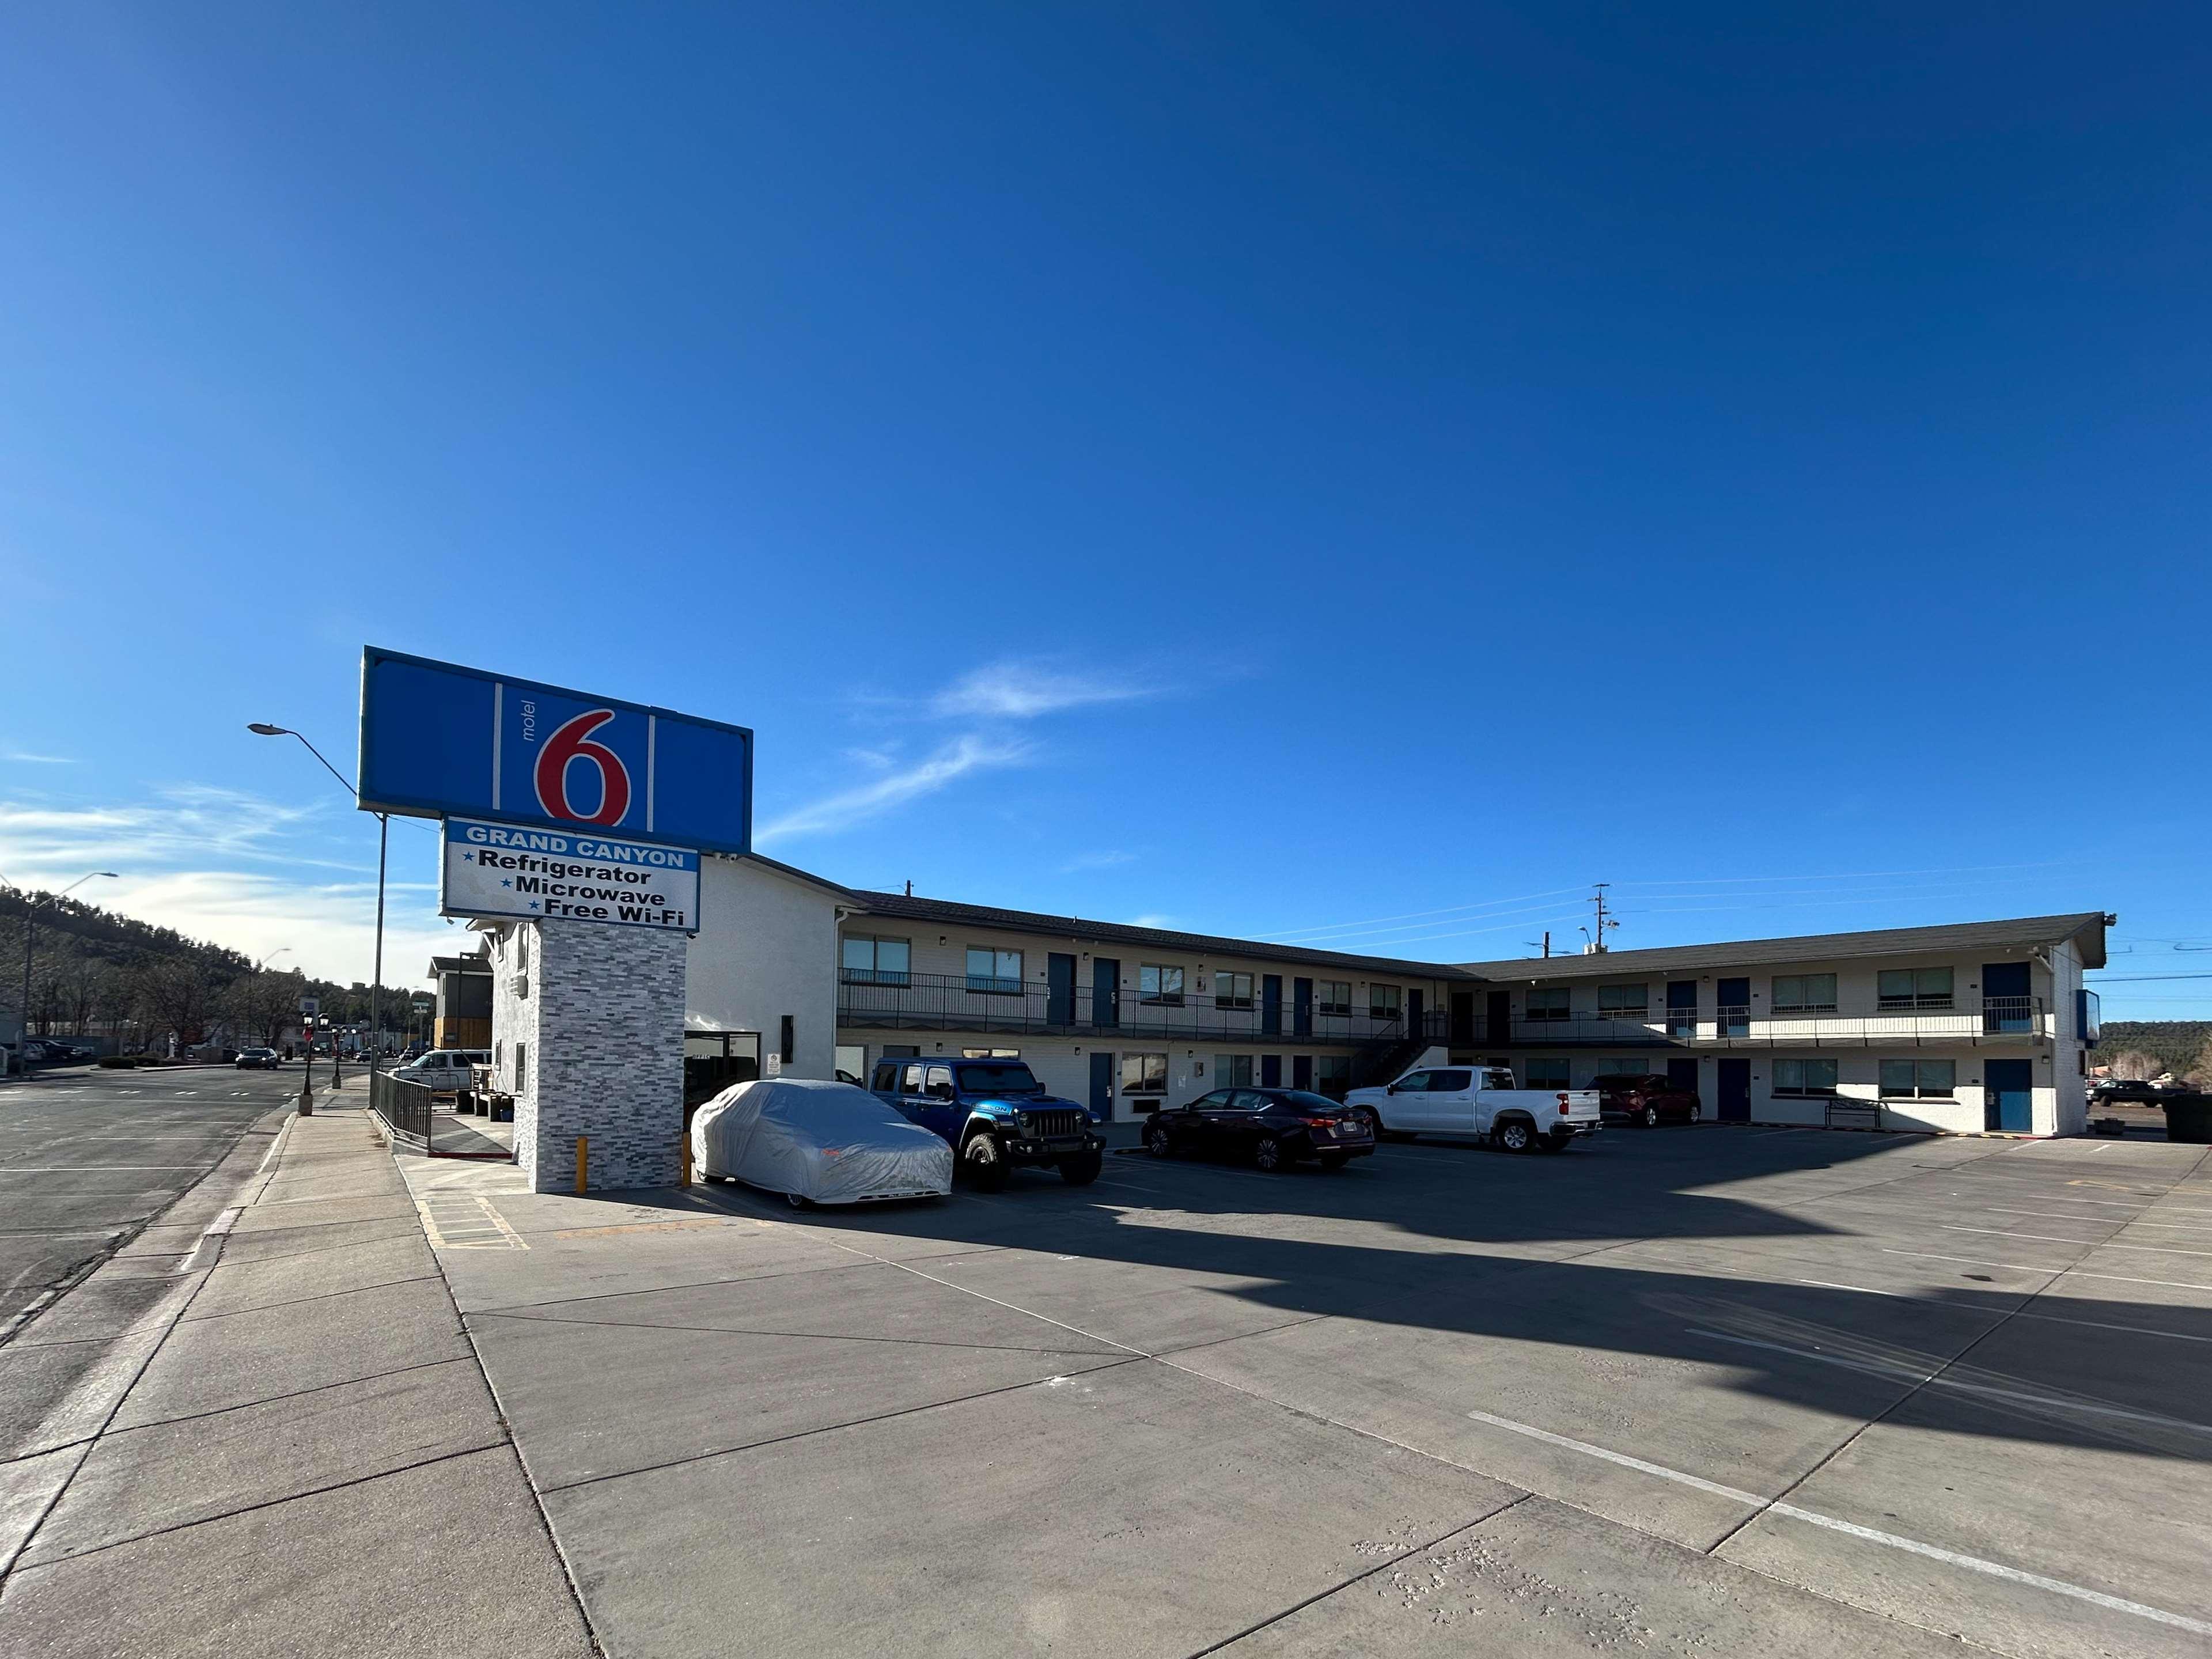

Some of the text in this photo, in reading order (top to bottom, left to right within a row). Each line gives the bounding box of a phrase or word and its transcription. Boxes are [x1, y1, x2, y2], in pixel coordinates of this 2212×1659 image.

[521, 700, 535, 741] motel
[533, 709, 631, 827] 6
[466, 826, 684, 868] GRAND CANYON
[479, 849, 651, 885] Refrigerator
[516, 876, 665, 906] Microwave
[544, 899, 684, 926] Free Wi-Fi
